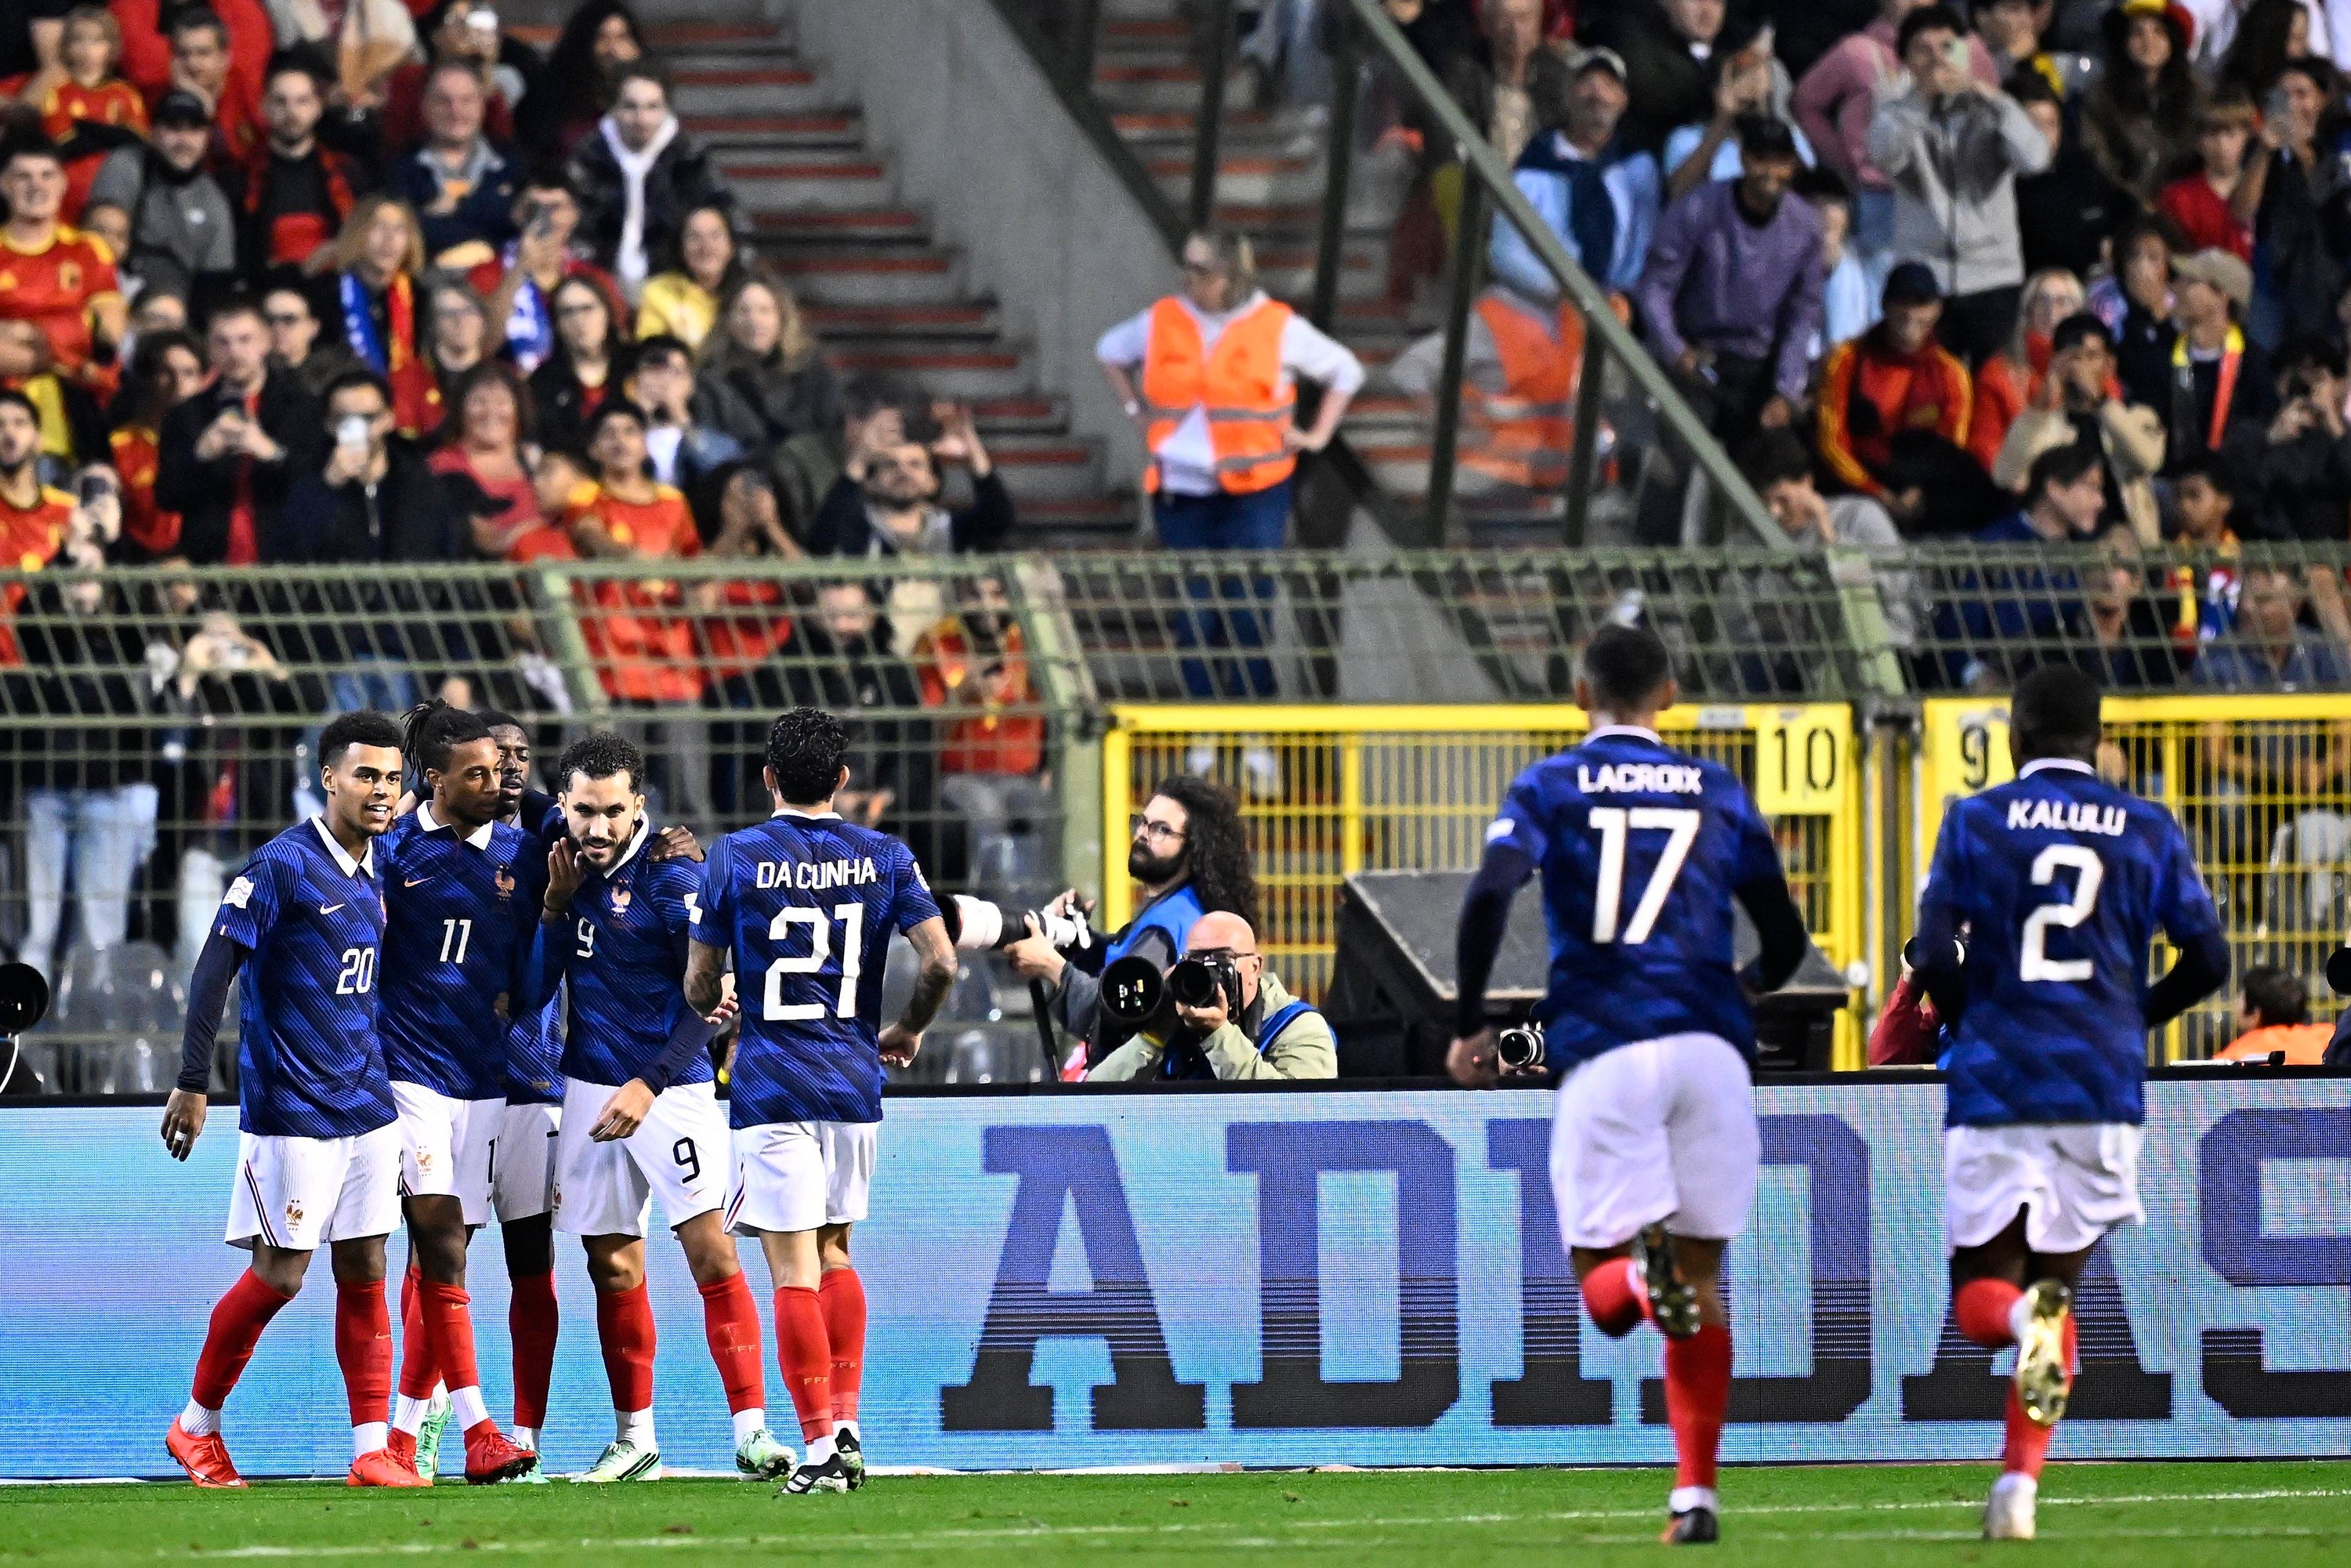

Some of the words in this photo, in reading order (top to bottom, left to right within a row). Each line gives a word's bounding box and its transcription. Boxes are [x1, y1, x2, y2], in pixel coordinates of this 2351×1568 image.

[1577, 763, 1704, 796] LACROIX
[1774, 727, 1837, 792] 10
[1961, 722, 1990, 790] 9
[2007, 798, 2127, 837] KALULU
[756, 861, 792, 889] DA
[795, 856, 877, 890] CUNHA
[1588, 806, 1701, 945] 17
[2020, 843, 2104, 983] 2
[440, 919, 472, 964] 11
[577, 917, 596, 958] 9
[763, 902, 864, 1021] 21
[335, 947, 375, 995] 20
[672, 1136, 701, 1184] 9
[803, 1376, 829, 1385] FFF
